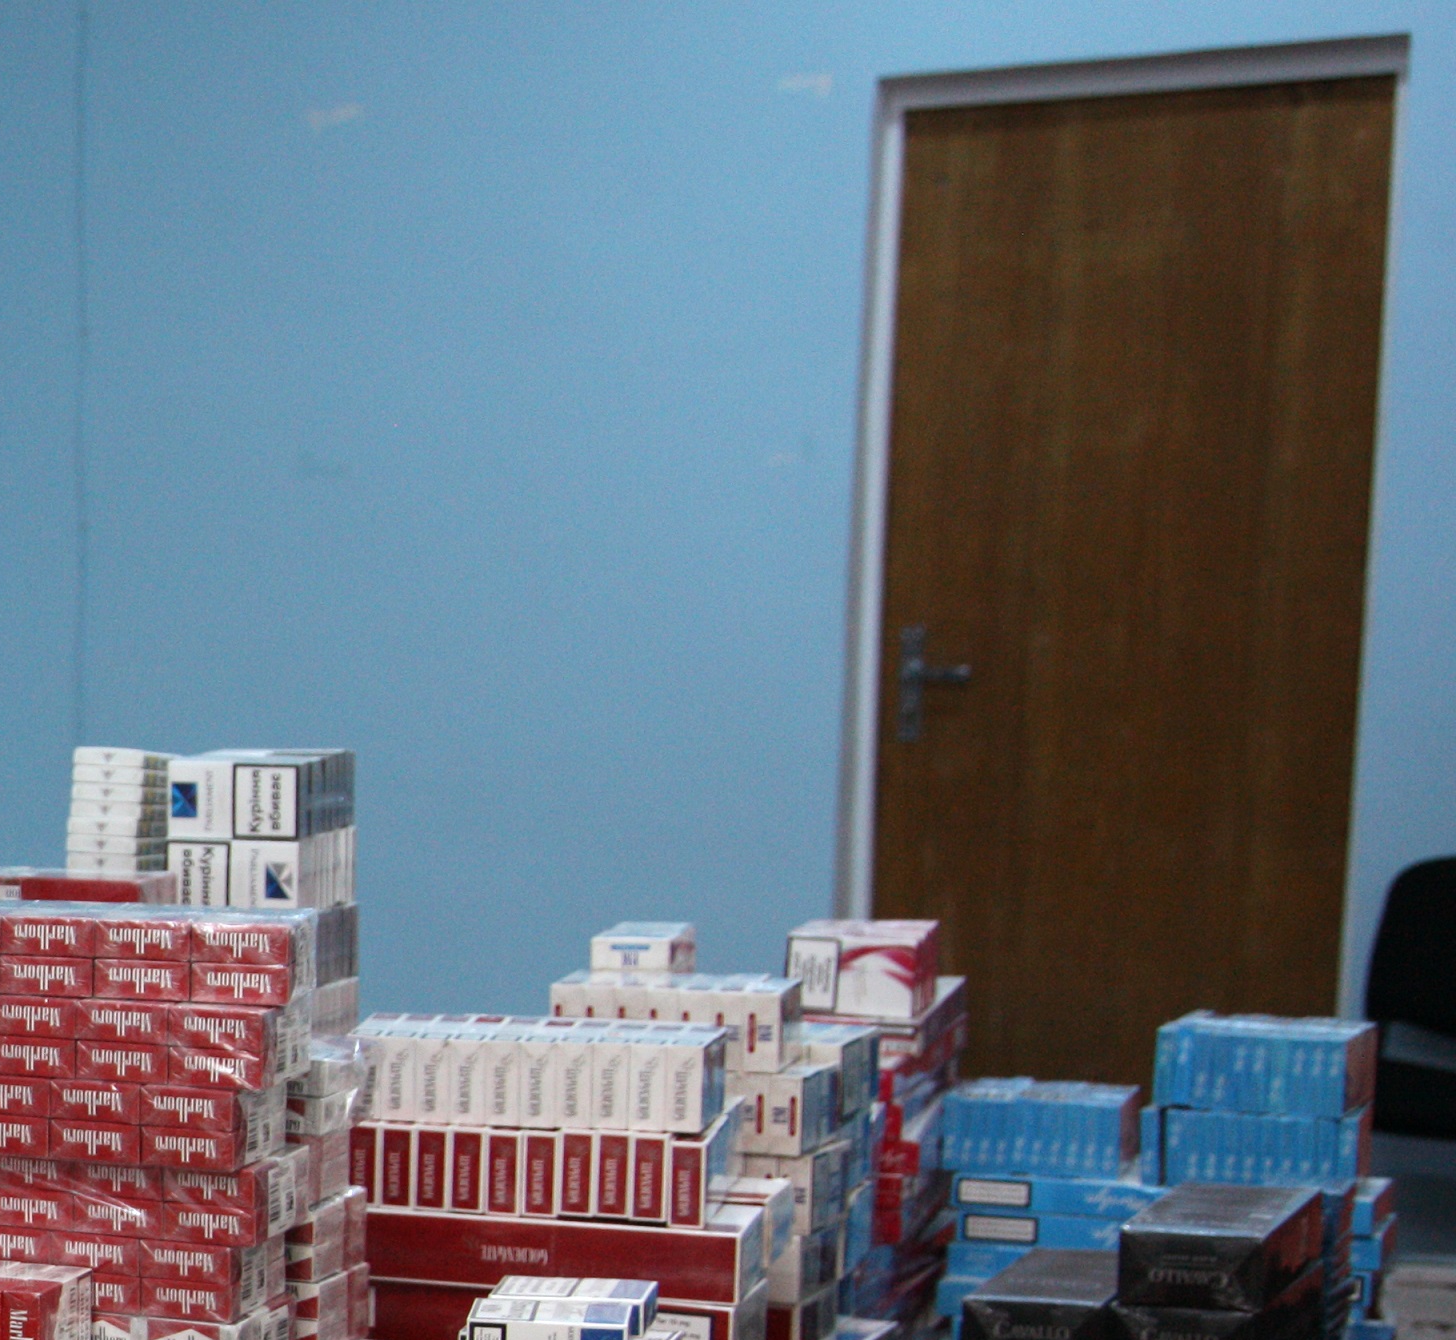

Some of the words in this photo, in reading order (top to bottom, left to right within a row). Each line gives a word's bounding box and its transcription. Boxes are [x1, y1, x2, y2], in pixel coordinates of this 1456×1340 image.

[250, 769, 261, 833] Куріння
[207, 971, 272, 999] Marlboro
[155, 1135, 217, 1162] Marlboro
[994, 1319, 1070, 1340] CAVALLO
